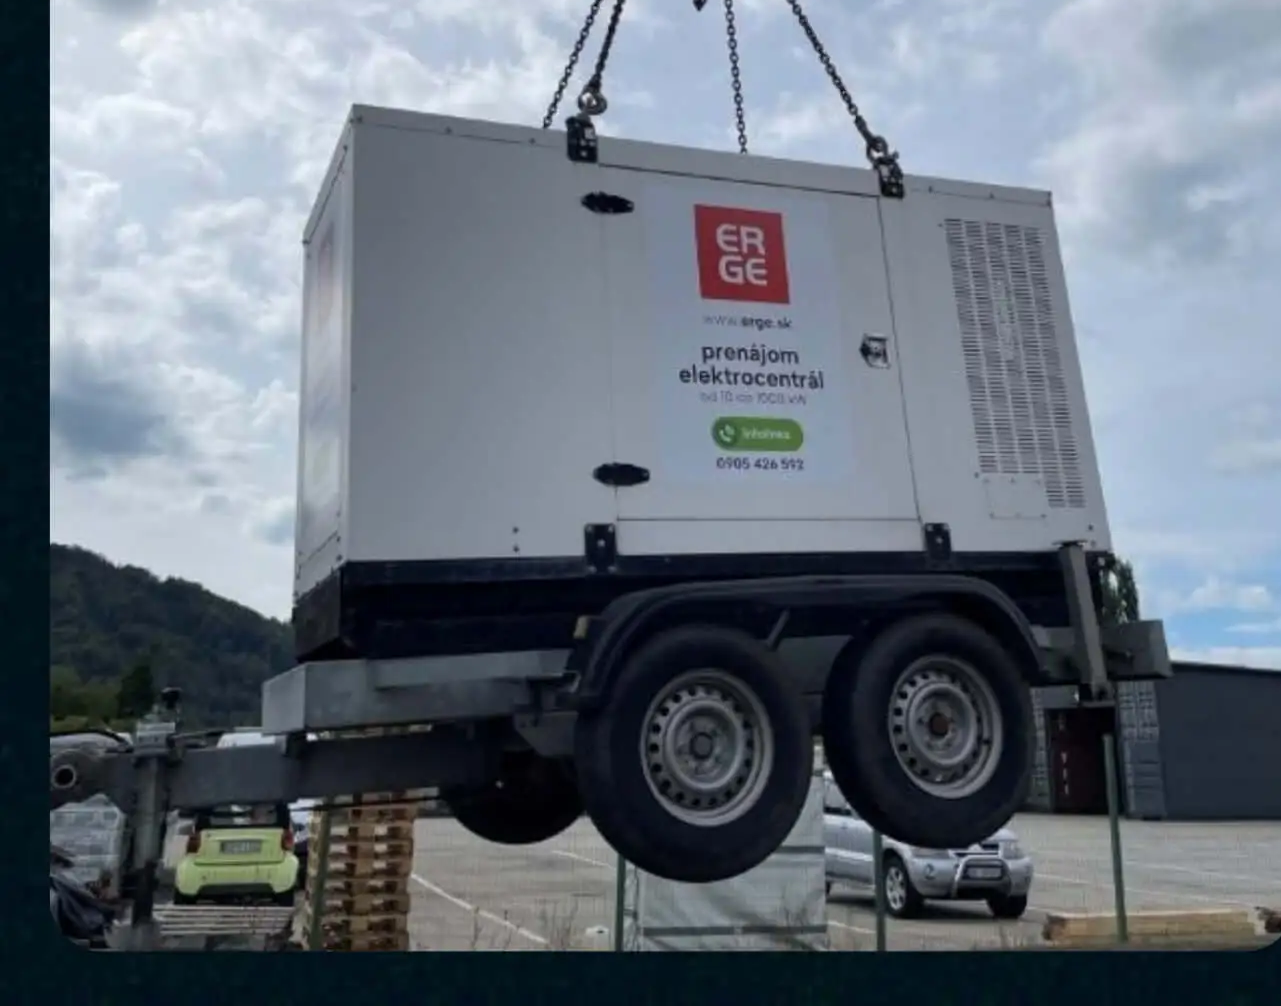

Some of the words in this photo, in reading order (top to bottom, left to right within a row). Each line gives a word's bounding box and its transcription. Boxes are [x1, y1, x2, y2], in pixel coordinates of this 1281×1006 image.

[716, 224, 766, 256] ER
[718, 255, 768, 286] GE
[701, 343, 799, 366] prenájom
[678, 364, 824, 389] elektrocentrál
[716, 456, 750, 470] 0905
[754, 457, 778, 470] 426
[780, 457, 804, 471] 592
